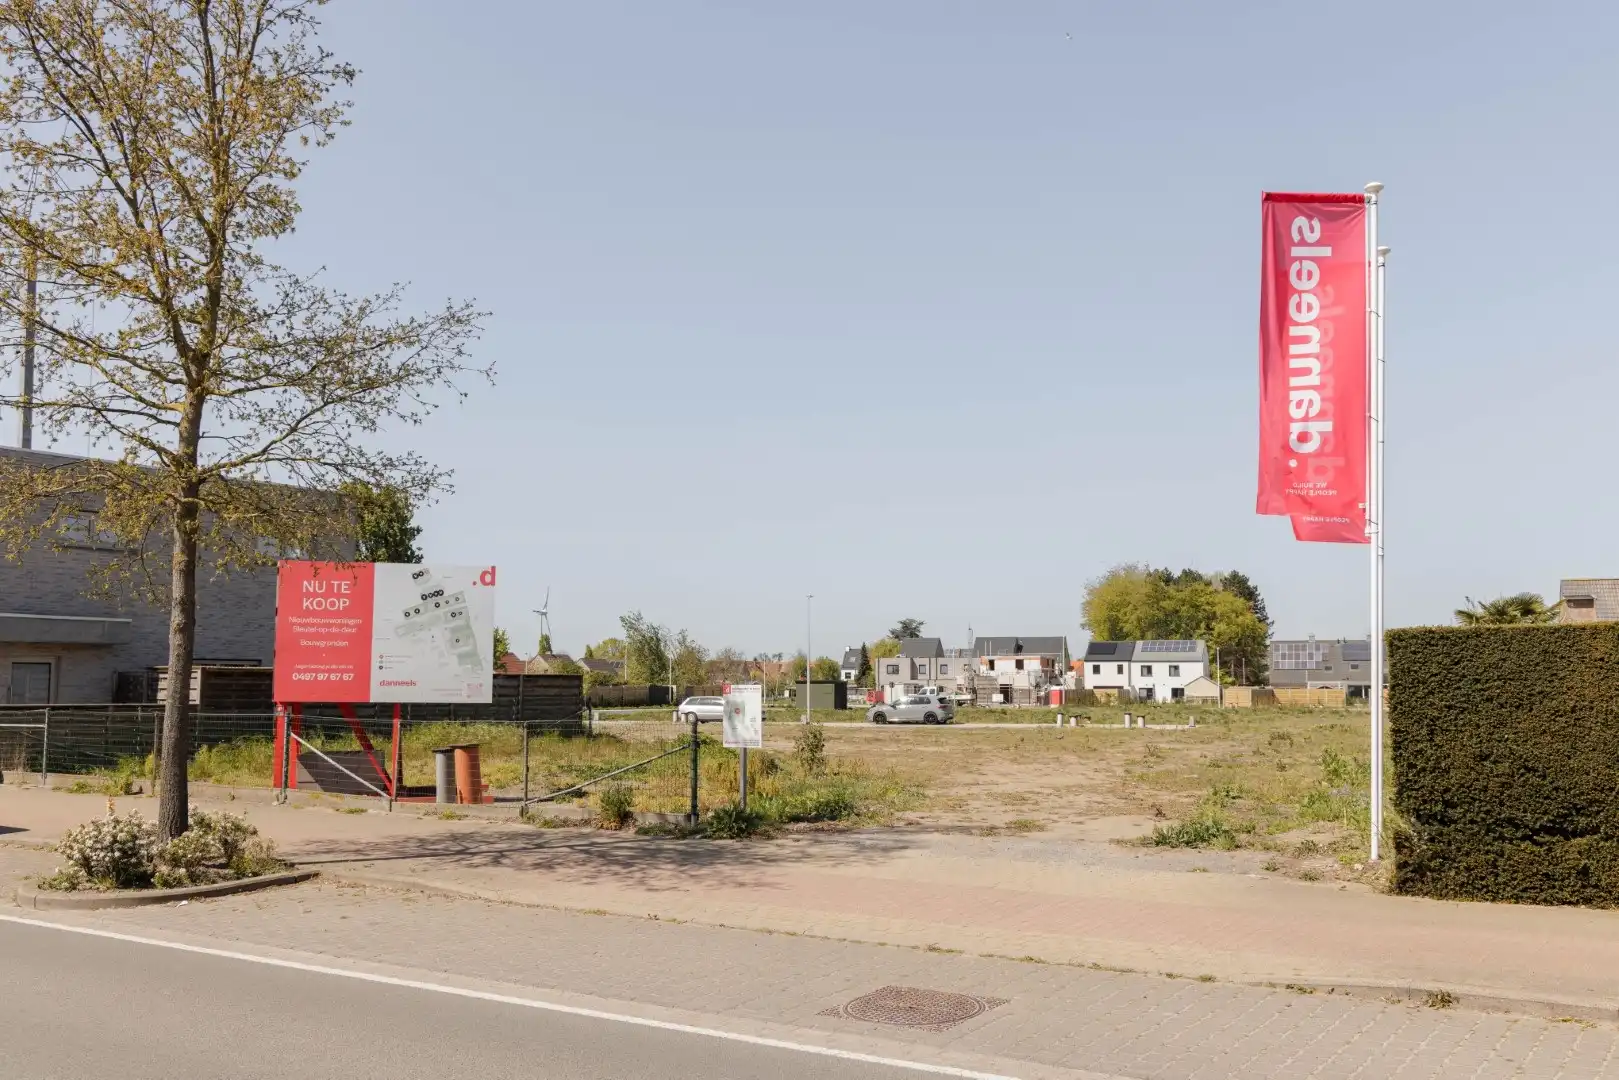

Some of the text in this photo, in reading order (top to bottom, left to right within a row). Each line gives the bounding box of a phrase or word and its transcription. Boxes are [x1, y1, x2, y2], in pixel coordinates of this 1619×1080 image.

[302, 580, 351, 593] NU TE
[302, 598, 350, 610] KOOP
[300, 639, 349, 648] Bouwgronden
[292, 673, 355, 681] 0497 97 67 67
[379, 679, 417, 687] danneels
